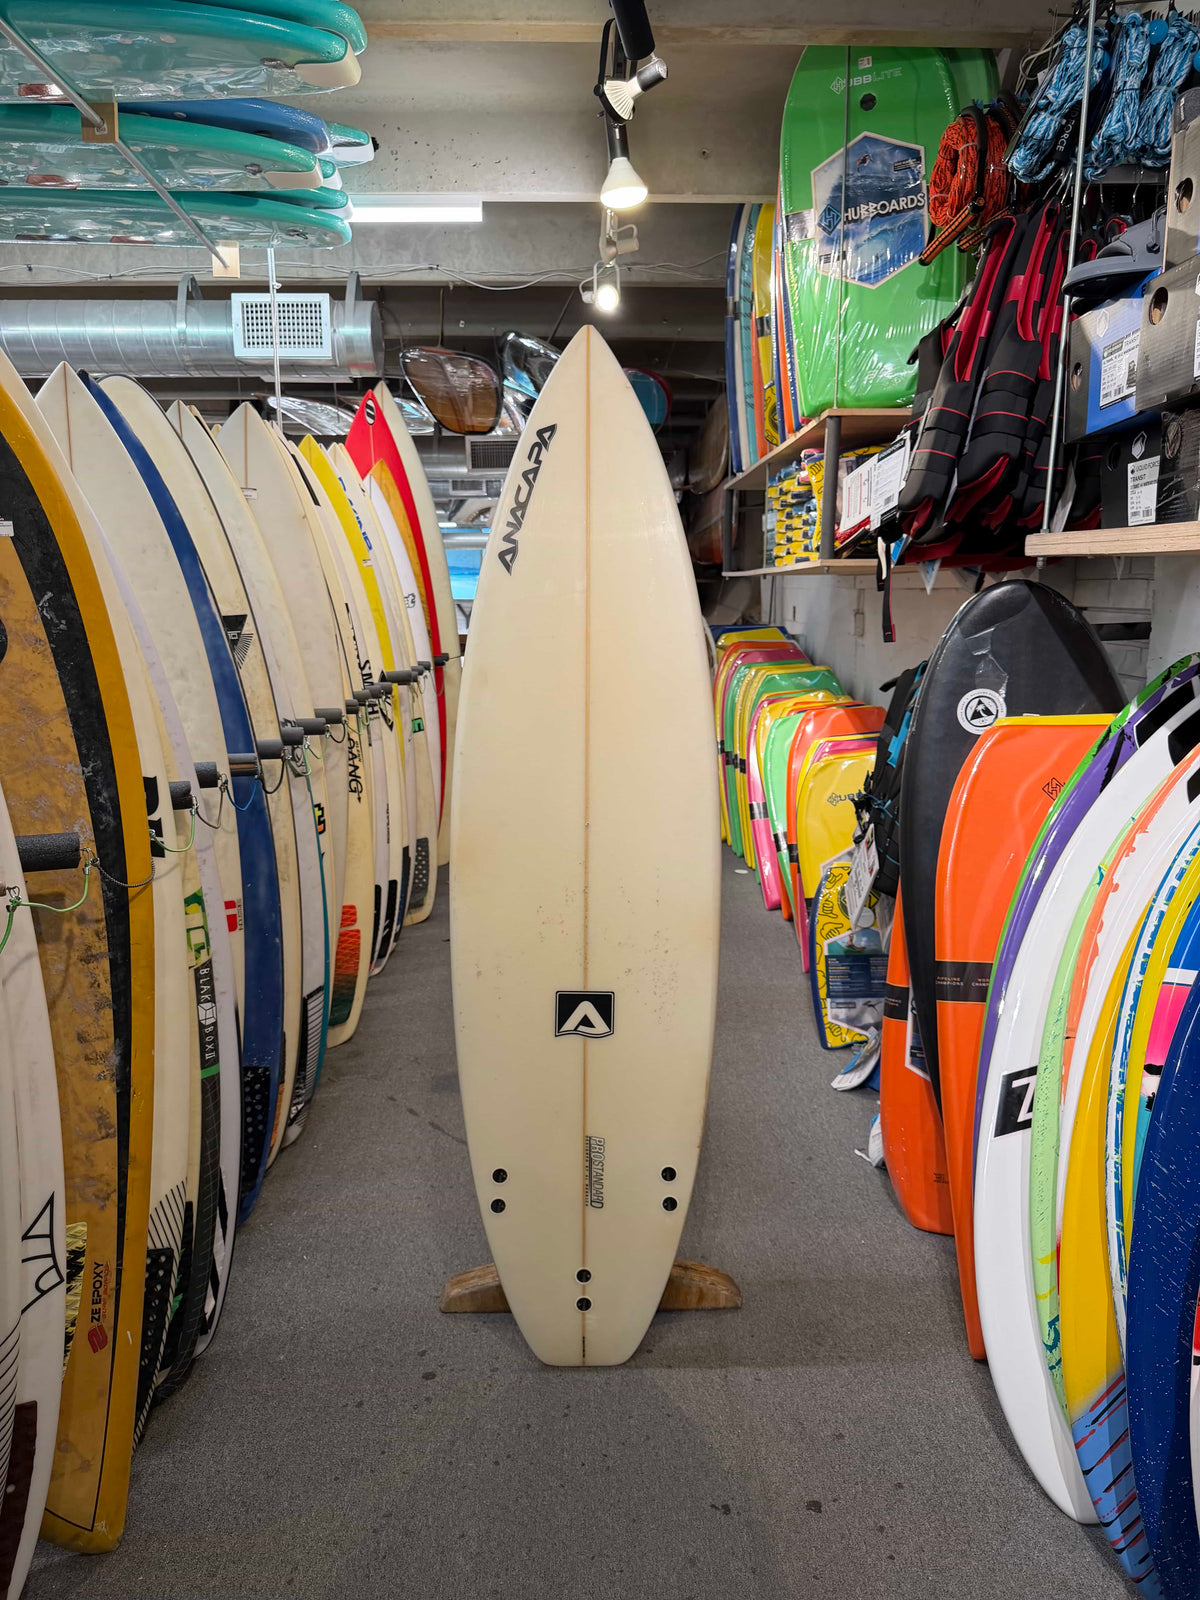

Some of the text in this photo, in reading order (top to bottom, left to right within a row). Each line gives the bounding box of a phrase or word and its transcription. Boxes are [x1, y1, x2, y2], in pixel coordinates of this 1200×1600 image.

[844, 193, 925, 220] HUBBOARDS
[498, 423, 557, 576] ANACAPA
[359, 659, 380, 715] SMH
[200, 967, 211, 1002] BLAK
[91, 1261, 103, 1323] ZE EPOXY
